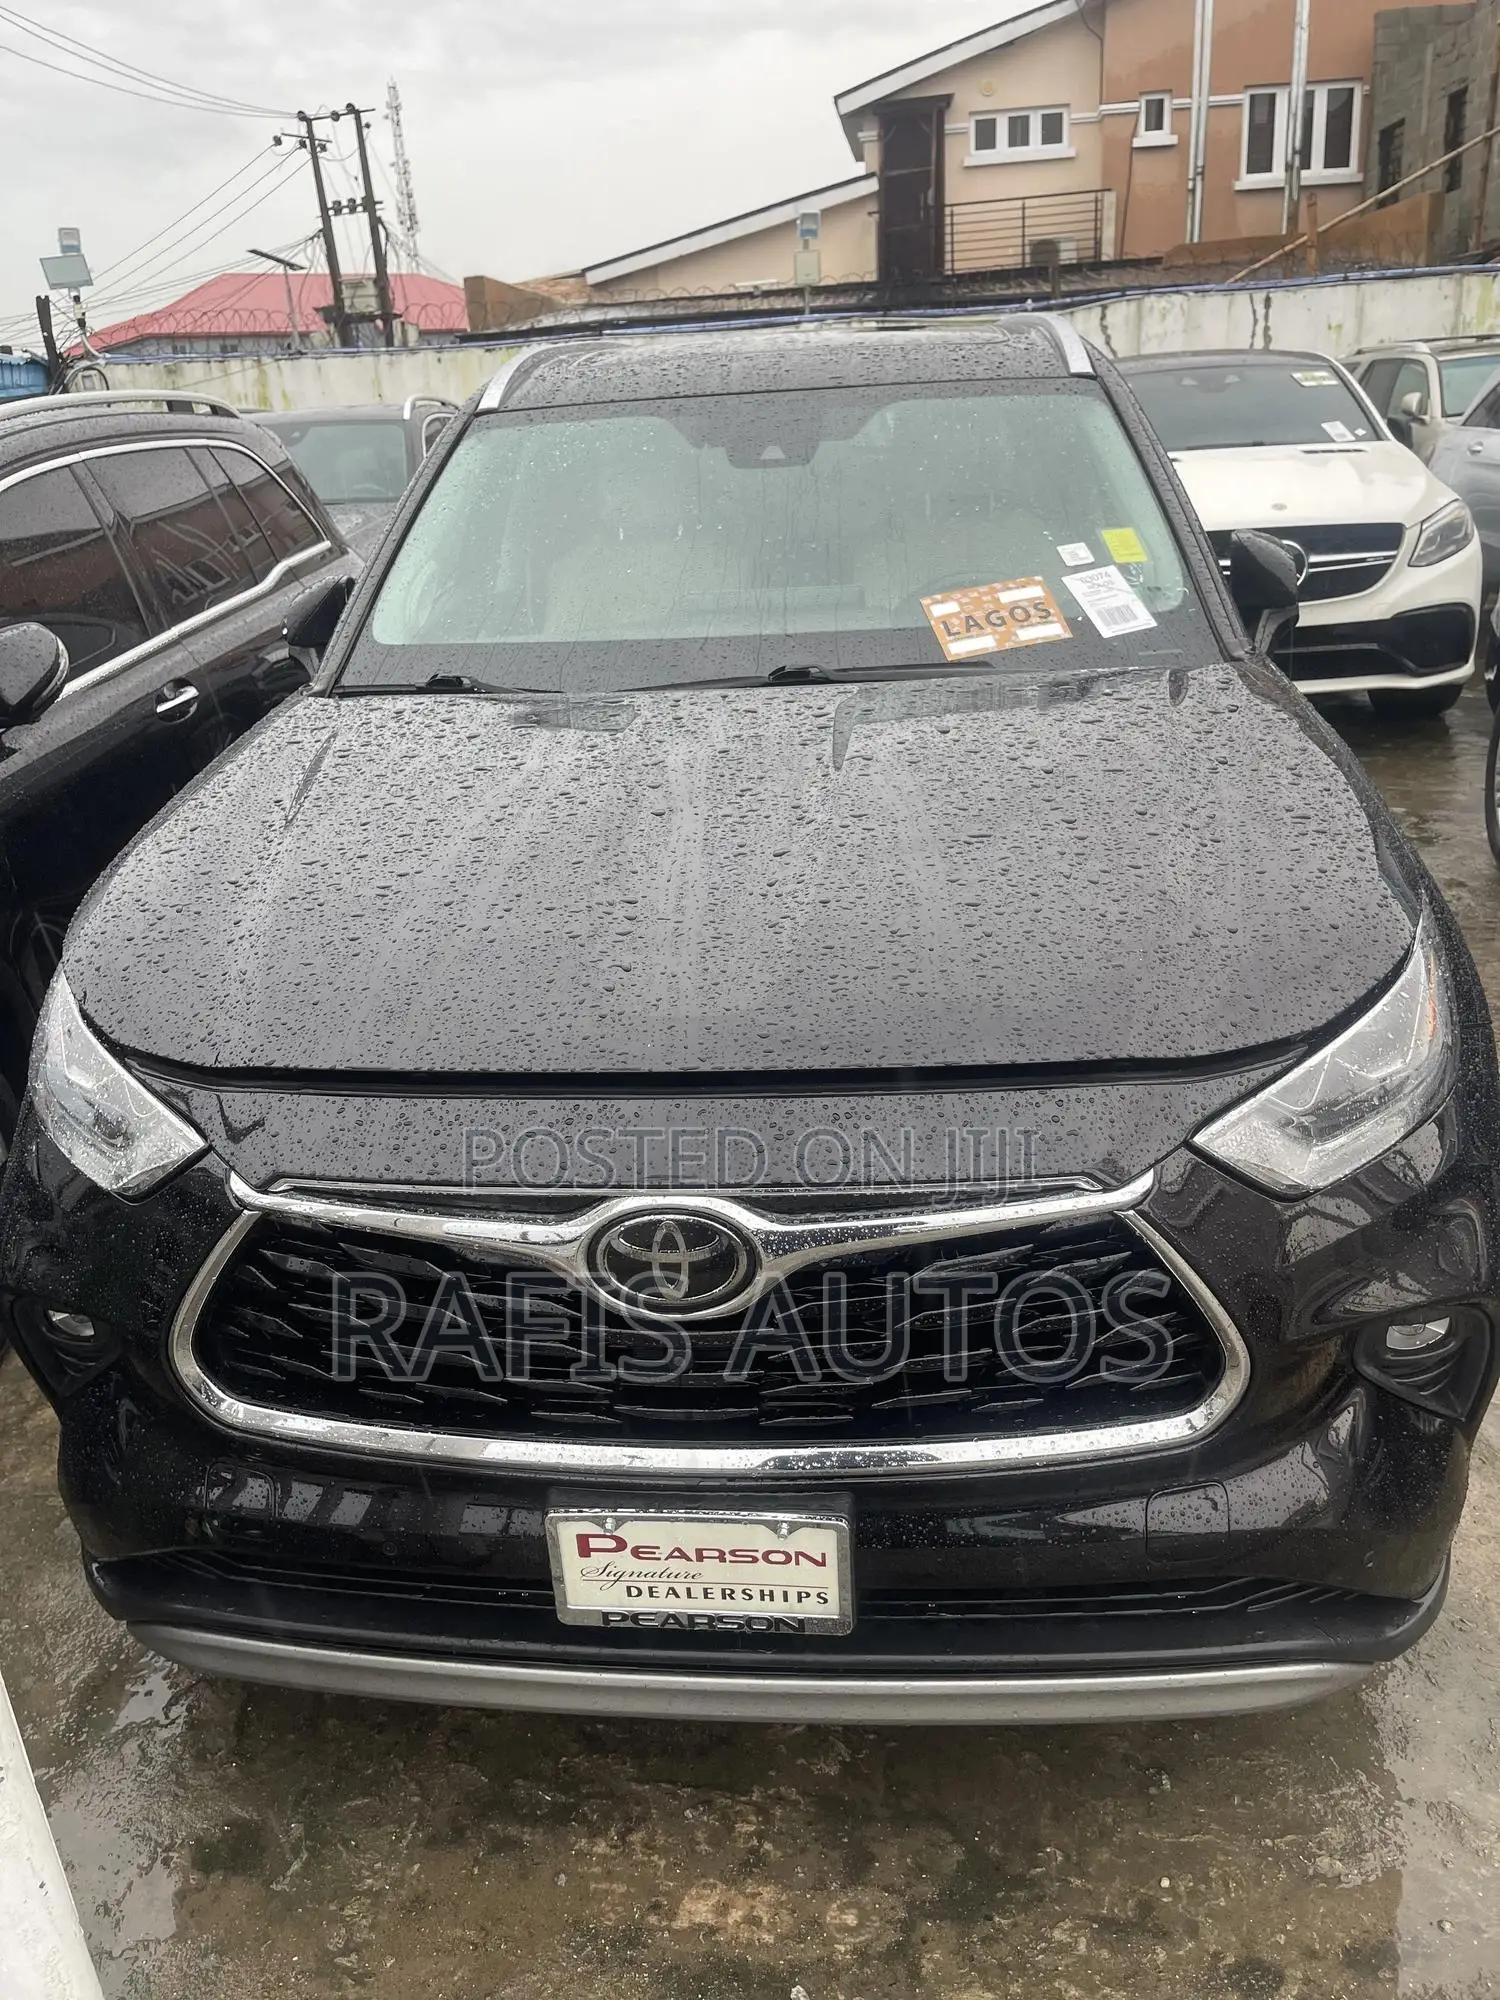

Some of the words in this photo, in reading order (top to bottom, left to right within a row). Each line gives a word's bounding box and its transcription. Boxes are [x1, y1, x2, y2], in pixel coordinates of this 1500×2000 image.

[941, 602, 1052, 637] LAGOS
[576, 1533, 828, 1568] PEARSON
[580, 1560, 704, 1591] Signature
[626, 1585, 829, 1605] DEALERSHIPS
[601, 1611, 806, 1633] PEARSON
